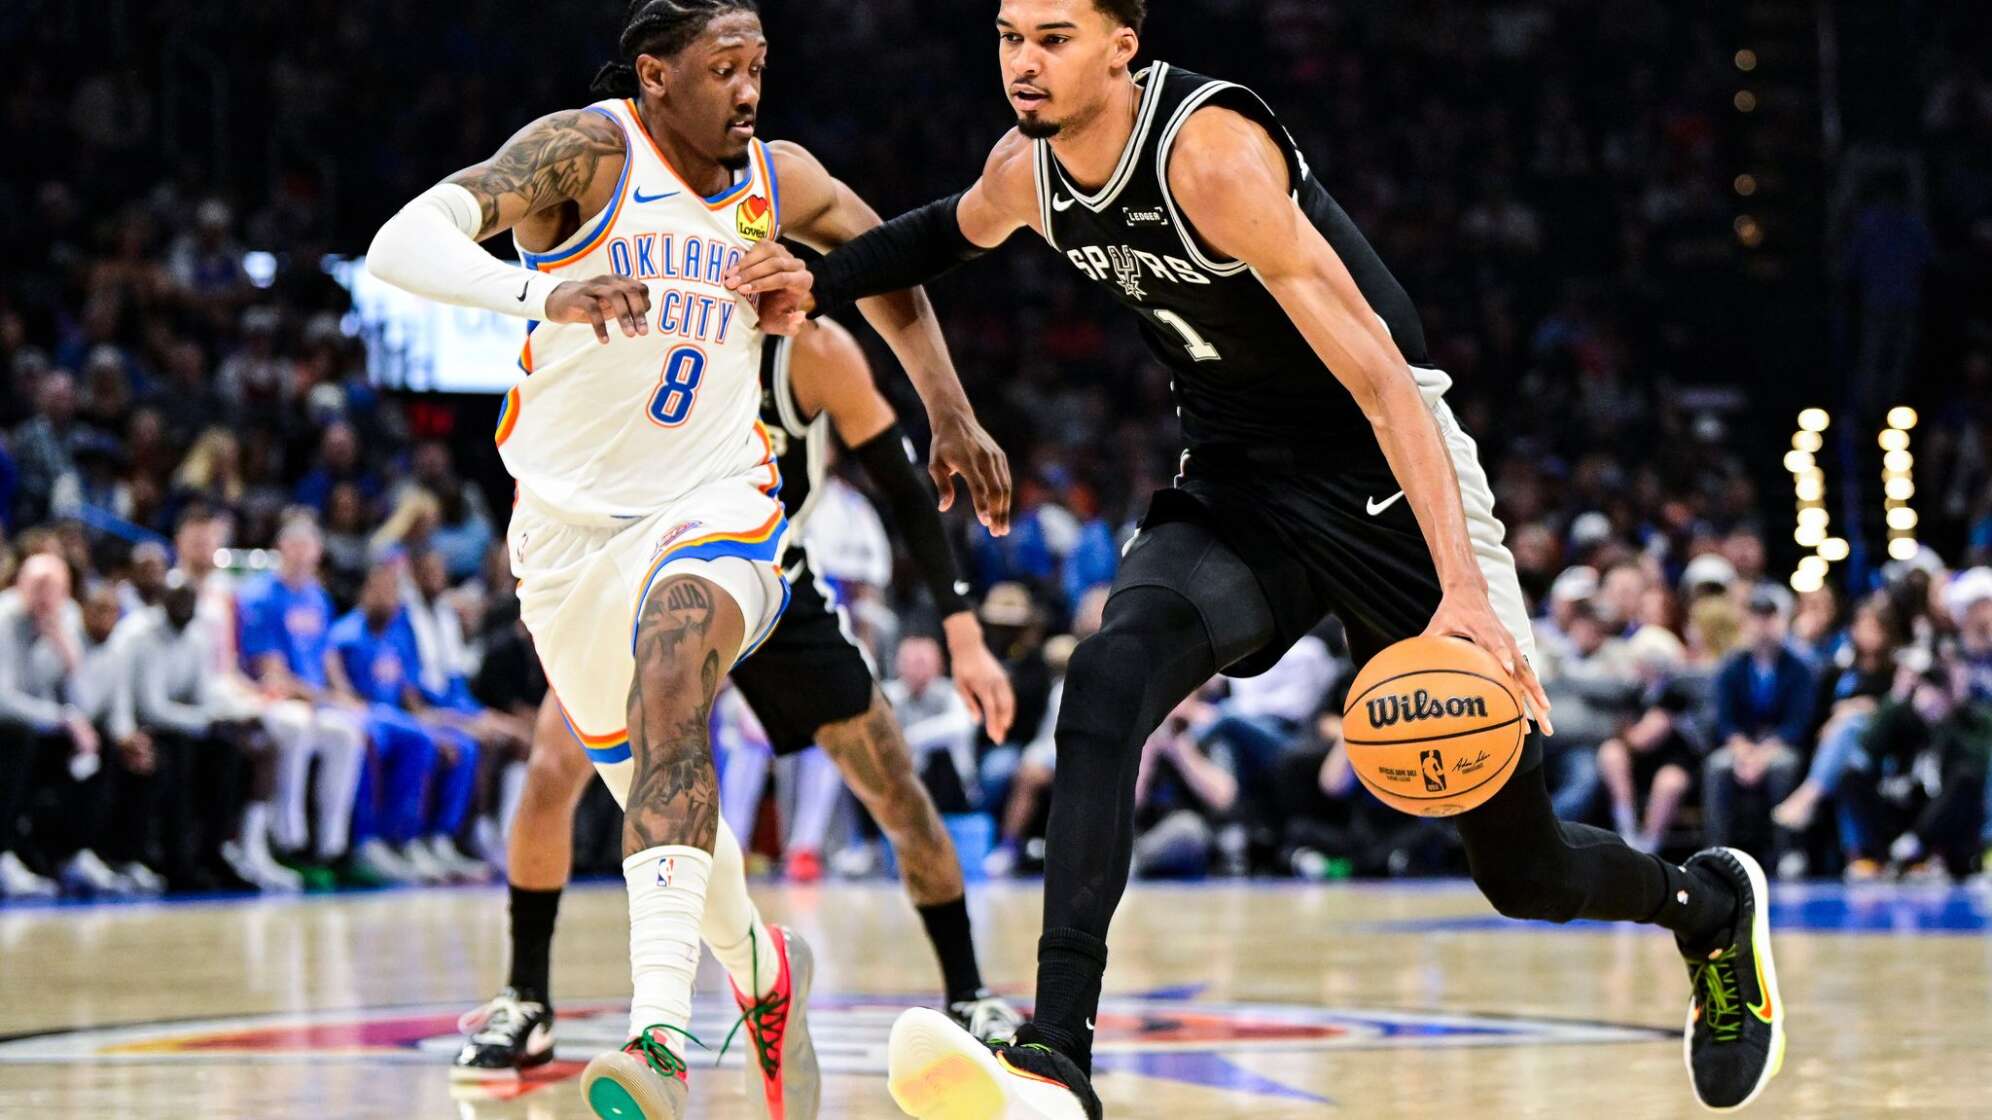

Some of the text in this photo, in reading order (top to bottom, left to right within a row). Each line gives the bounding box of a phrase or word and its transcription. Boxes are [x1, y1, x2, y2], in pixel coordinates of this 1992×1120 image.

[1128, 211, 1161, 222] LEDGER
[1066, 244, 1211, 301] SPURS
[657, 288, 737, 344] CITY
[1153, 308, 1222, 362] 1
[646, 342, 708, 429] 8
[1365, 687, 1489, 730] Wilson
